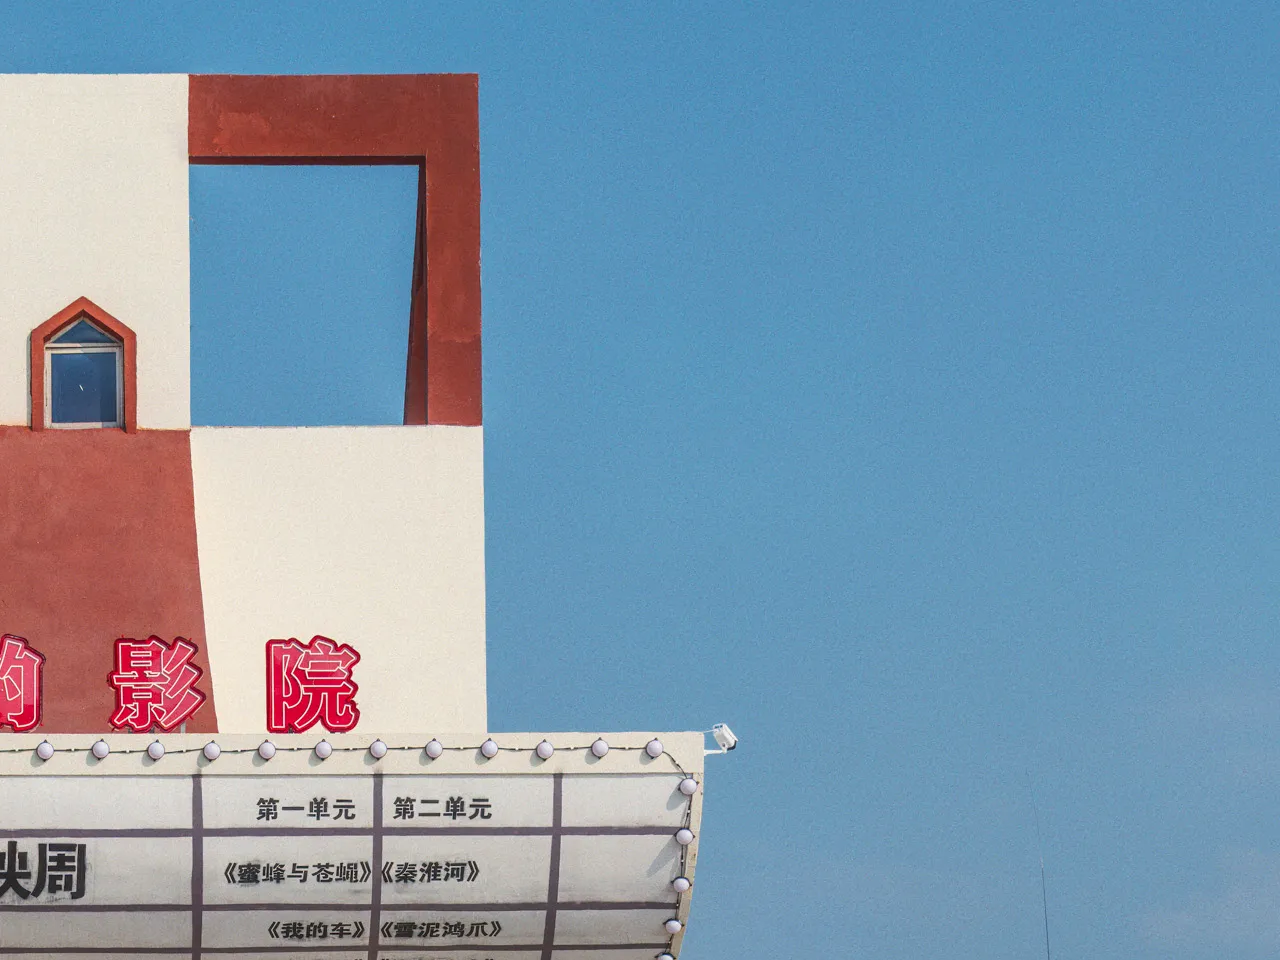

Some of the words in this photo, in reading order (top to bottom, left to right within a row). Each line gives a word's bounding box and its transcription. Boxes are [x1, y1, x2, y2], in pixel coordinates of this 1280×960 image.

[256, 797, 356, 820] 第一单元
[393, 796, 492, 820] 第二单元
[223, 862, 372, 884] 《蜜蜂与苍蝇》
[381, 860, 480, 883] 《秦淮河》
[268, 921, 365, 939] 《我的车》
[380, 920, 502, 938] 《雪泥鸿爪》
